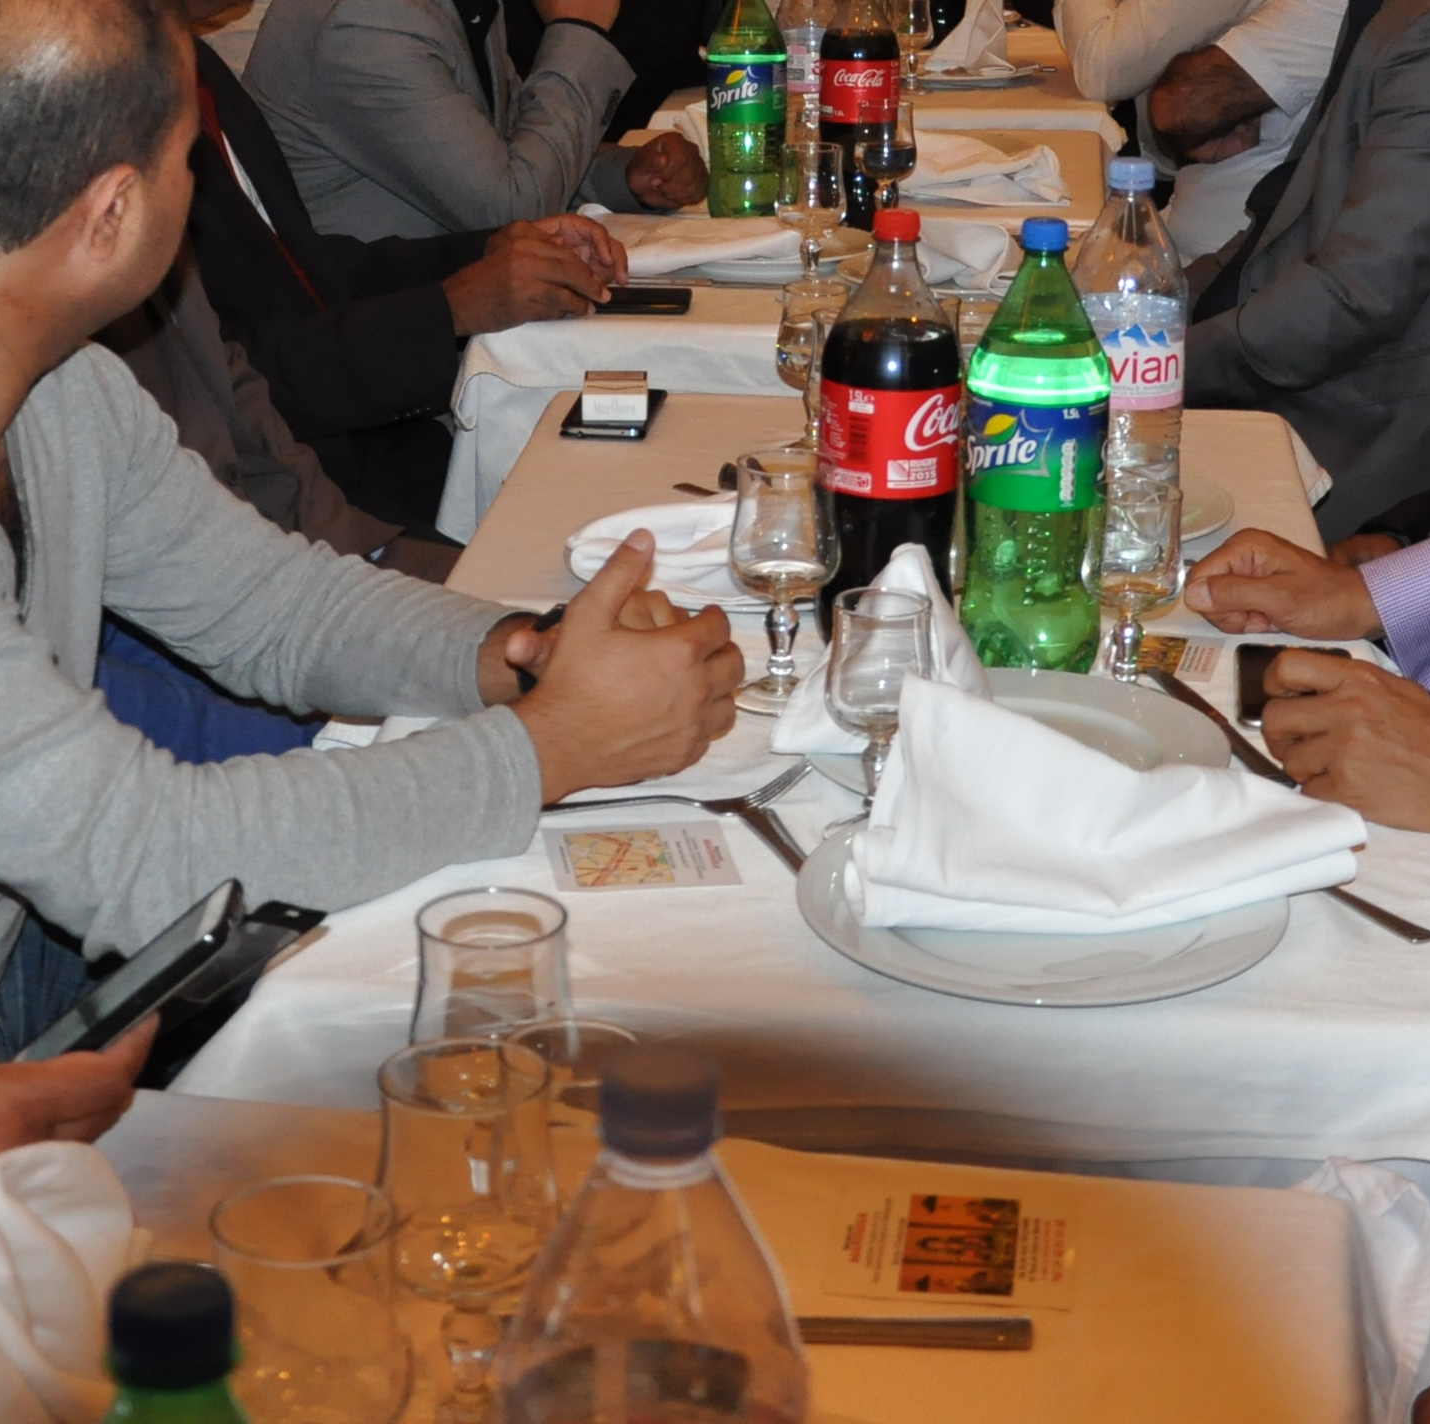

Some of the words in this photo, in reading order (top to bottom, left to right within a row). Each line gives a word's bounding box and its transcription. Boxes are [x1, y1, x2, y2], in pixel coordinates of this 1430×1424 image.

[834, 68, 885, 87] Coca-Cola
[710, 80, 758, 110] Sprite
[1109, 351, 1180, 385] vian
[965, 429, 1037, 476] Sprite
